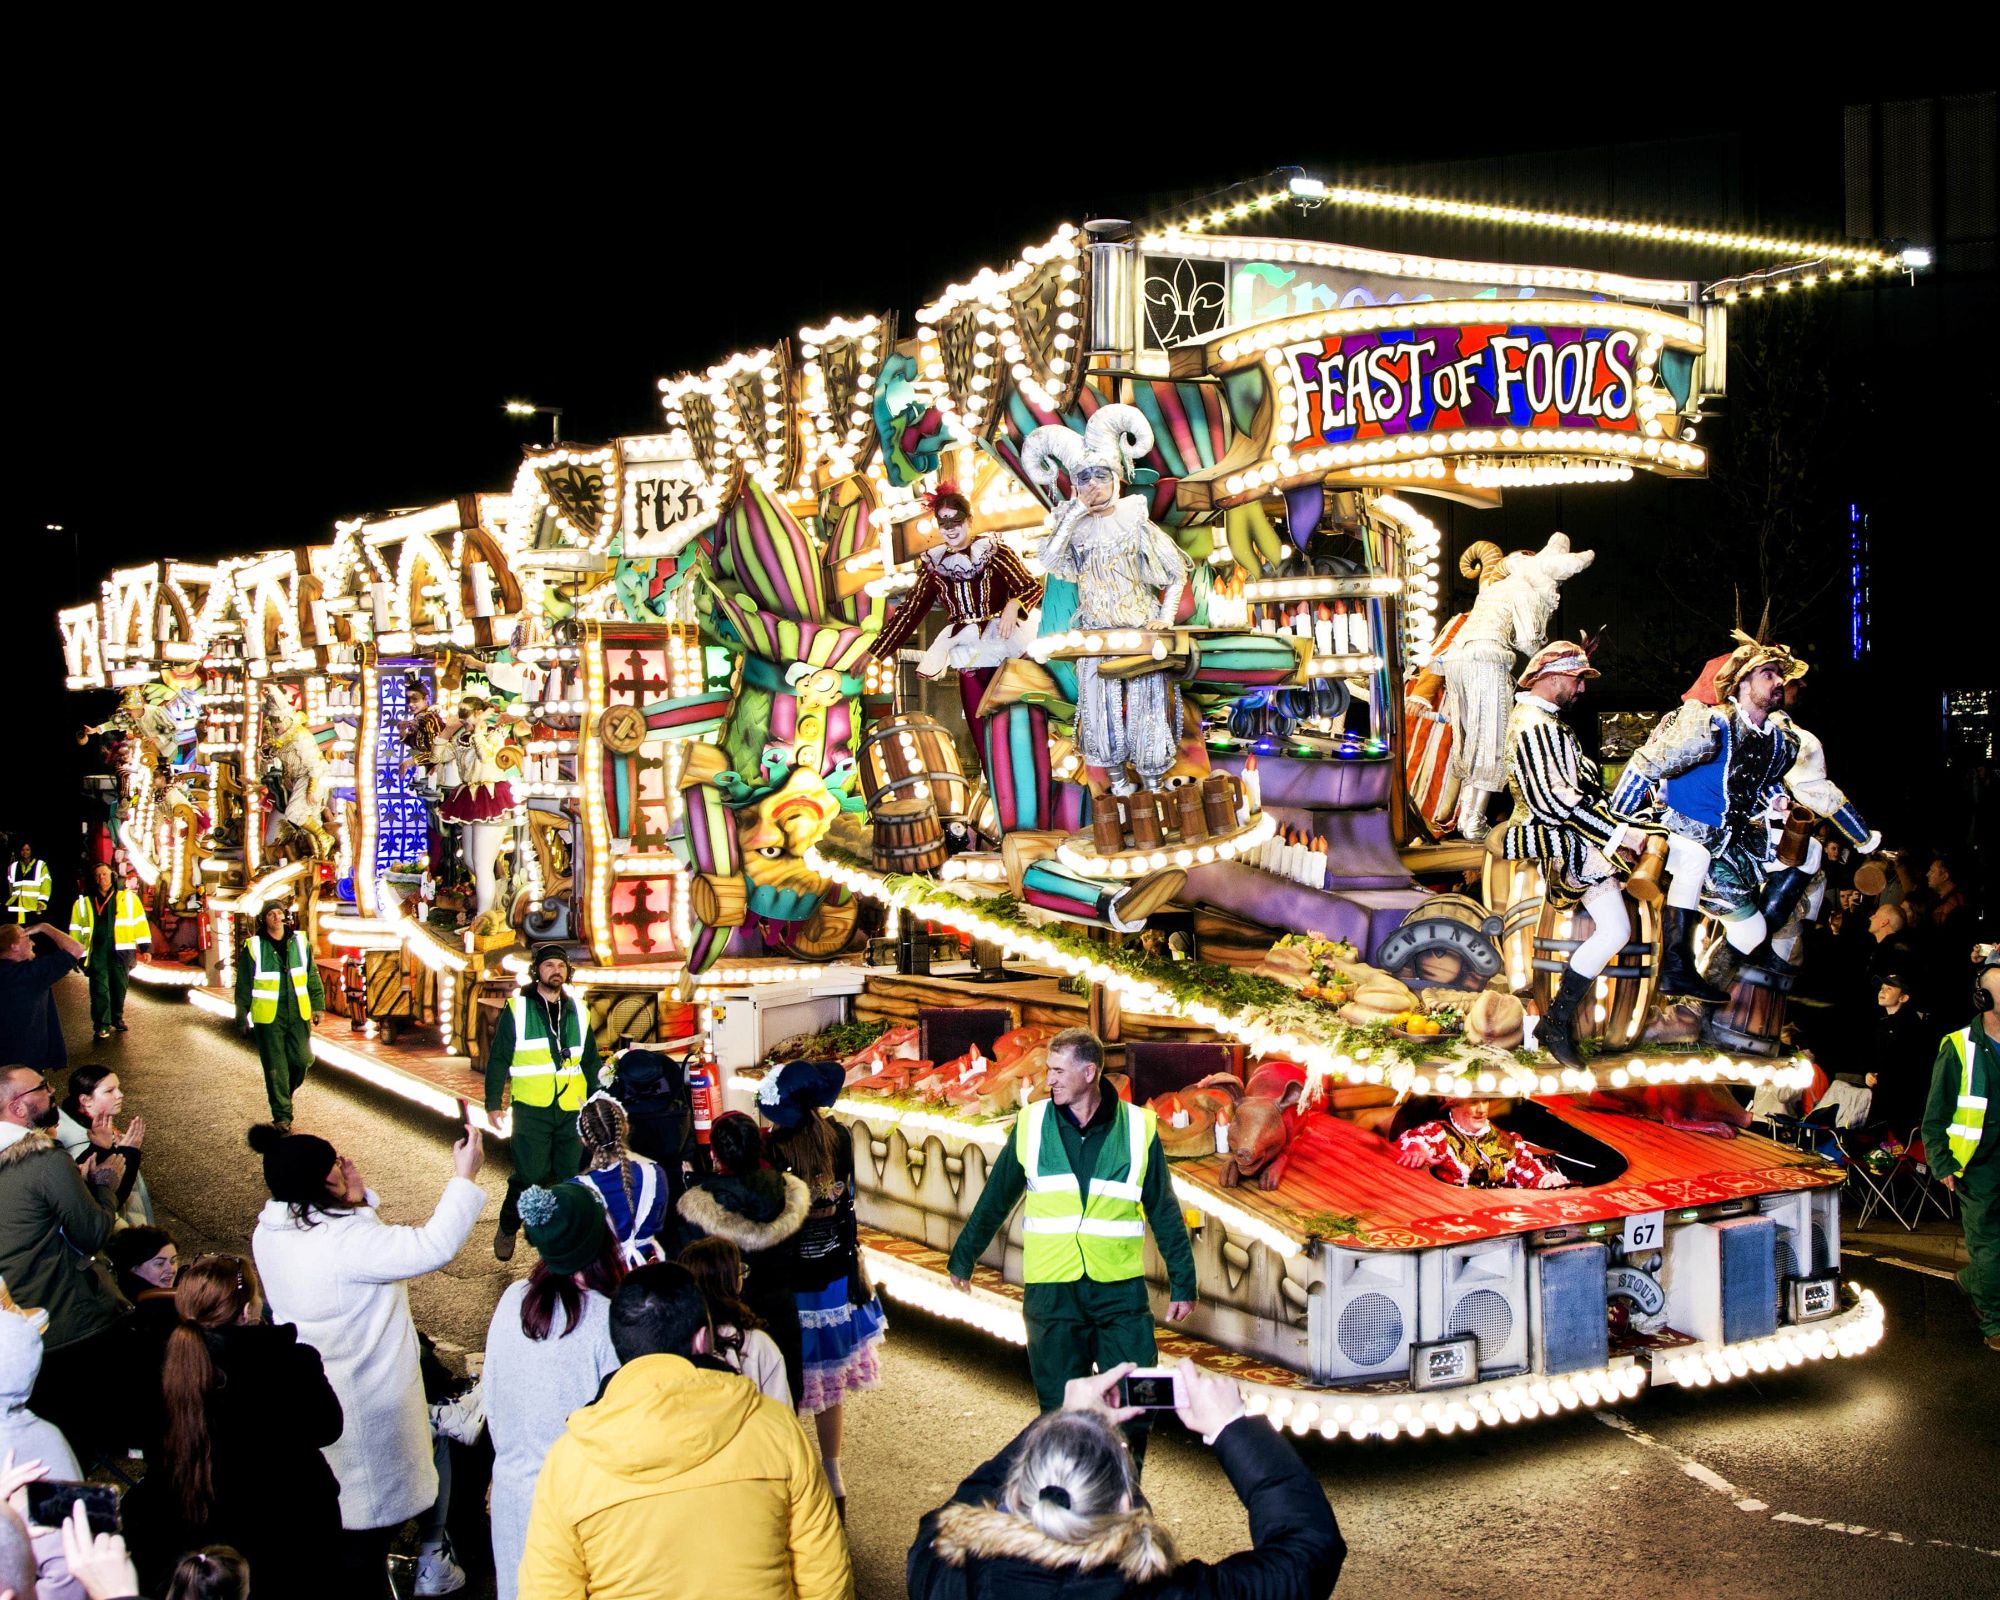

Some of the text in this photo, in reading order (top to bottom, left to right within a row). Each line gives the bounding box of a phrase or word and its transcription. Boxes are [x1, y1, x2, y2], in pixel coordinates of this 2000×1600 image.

[1282, 331, 1638, 442] FEAST OF FOOLS
[1401, 925, 1480, 952] WINE
[1633, 1224, 1655, 1245] 67
[1619, 1274, 1657, 1306] STOUT
